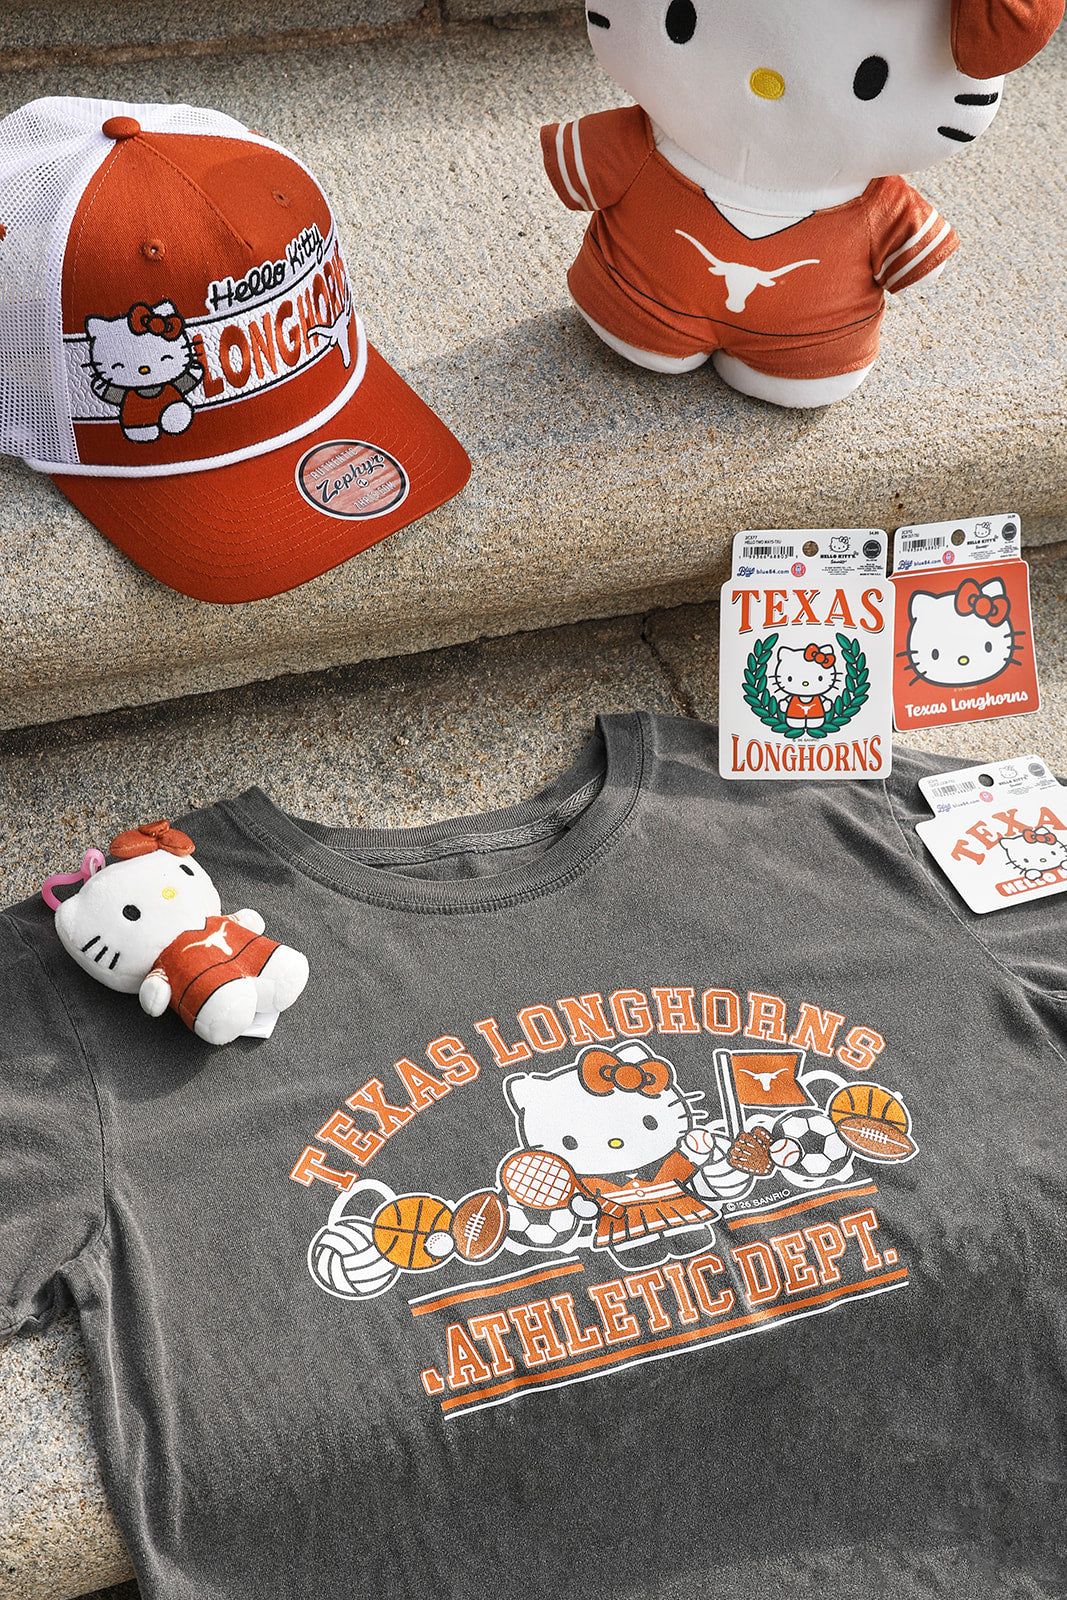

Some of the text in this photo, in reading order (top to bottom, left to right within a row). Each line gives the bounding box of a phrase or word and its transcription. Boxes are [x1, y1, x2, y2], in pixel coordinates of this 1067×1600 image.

[209, 225, 324, 311] Hello Kitty
[310, 447, 359, 480] AUTHENTIC
[316, 454, 385, 504] Zephyr
[353, 480, 397, 511] ZHATS.COM
[731, 588, 885, 634] TEXAS
[905, 690, 1029, 718] Texas Longhorns
[731, 733, 883, 772] LONGHORNS
[950, 806, 1067, 865] TEXA
[1002, 872, 1057, 894] HELLO
[289, 986, 887, 1193] TEXAS LONGHORNS
[752, 1188, 791, 1207] SANRIO
[732, 1207, 899, 1308] DEPT.
